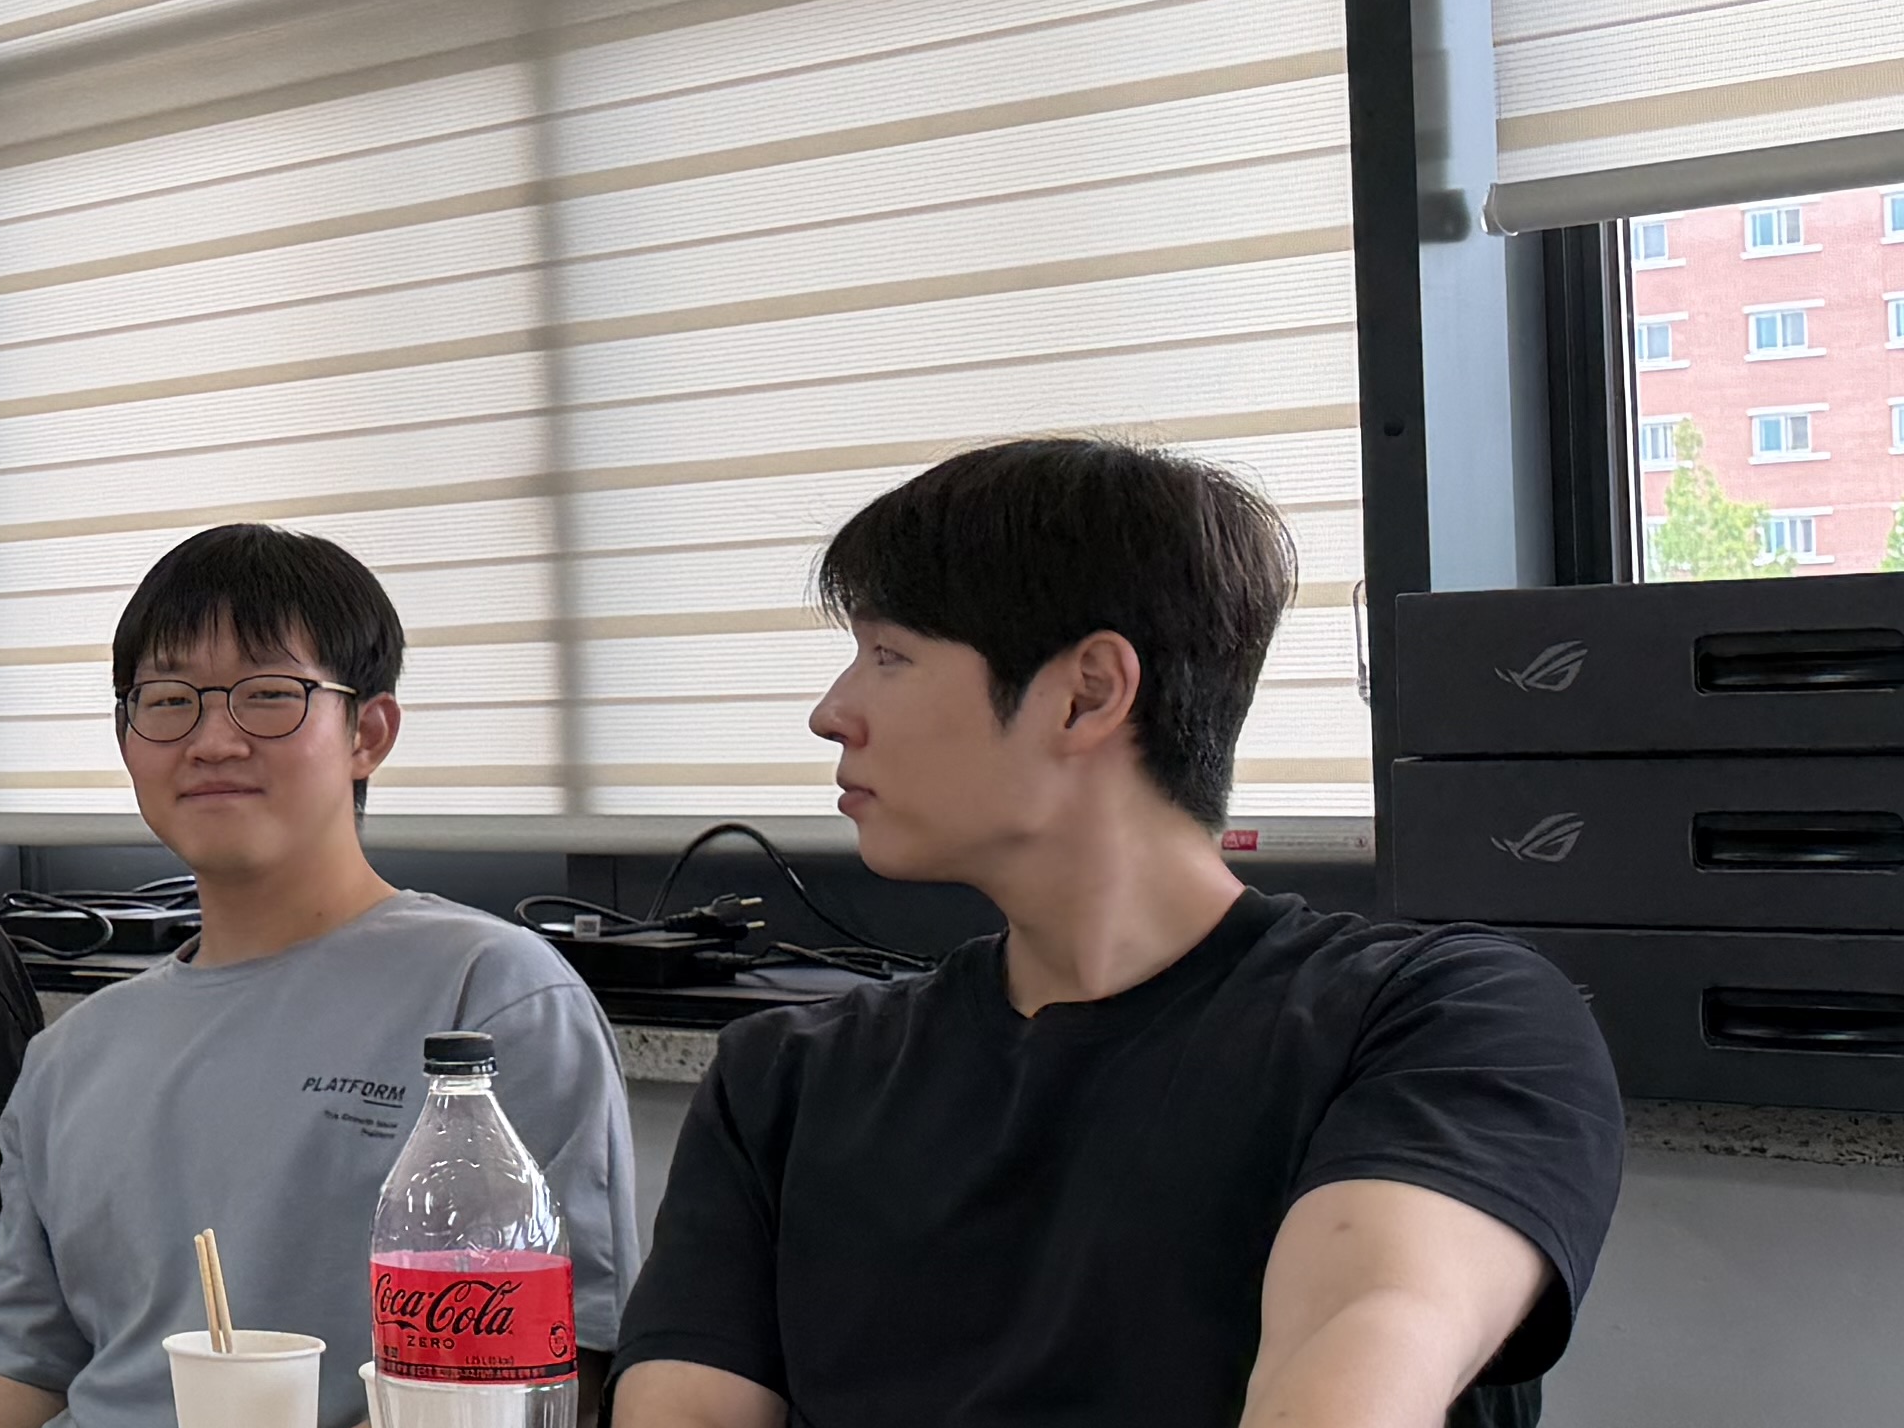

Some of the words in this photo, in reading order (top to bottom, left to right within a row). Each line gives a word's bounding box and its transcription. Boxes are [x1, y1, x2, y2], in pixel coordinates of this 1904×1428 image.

[301, 1076, 406, 1102] PLATFORM
[374, 1273, 523, 1336] Coca-Cola
[406, 1334, 456, 1350] ZERO
